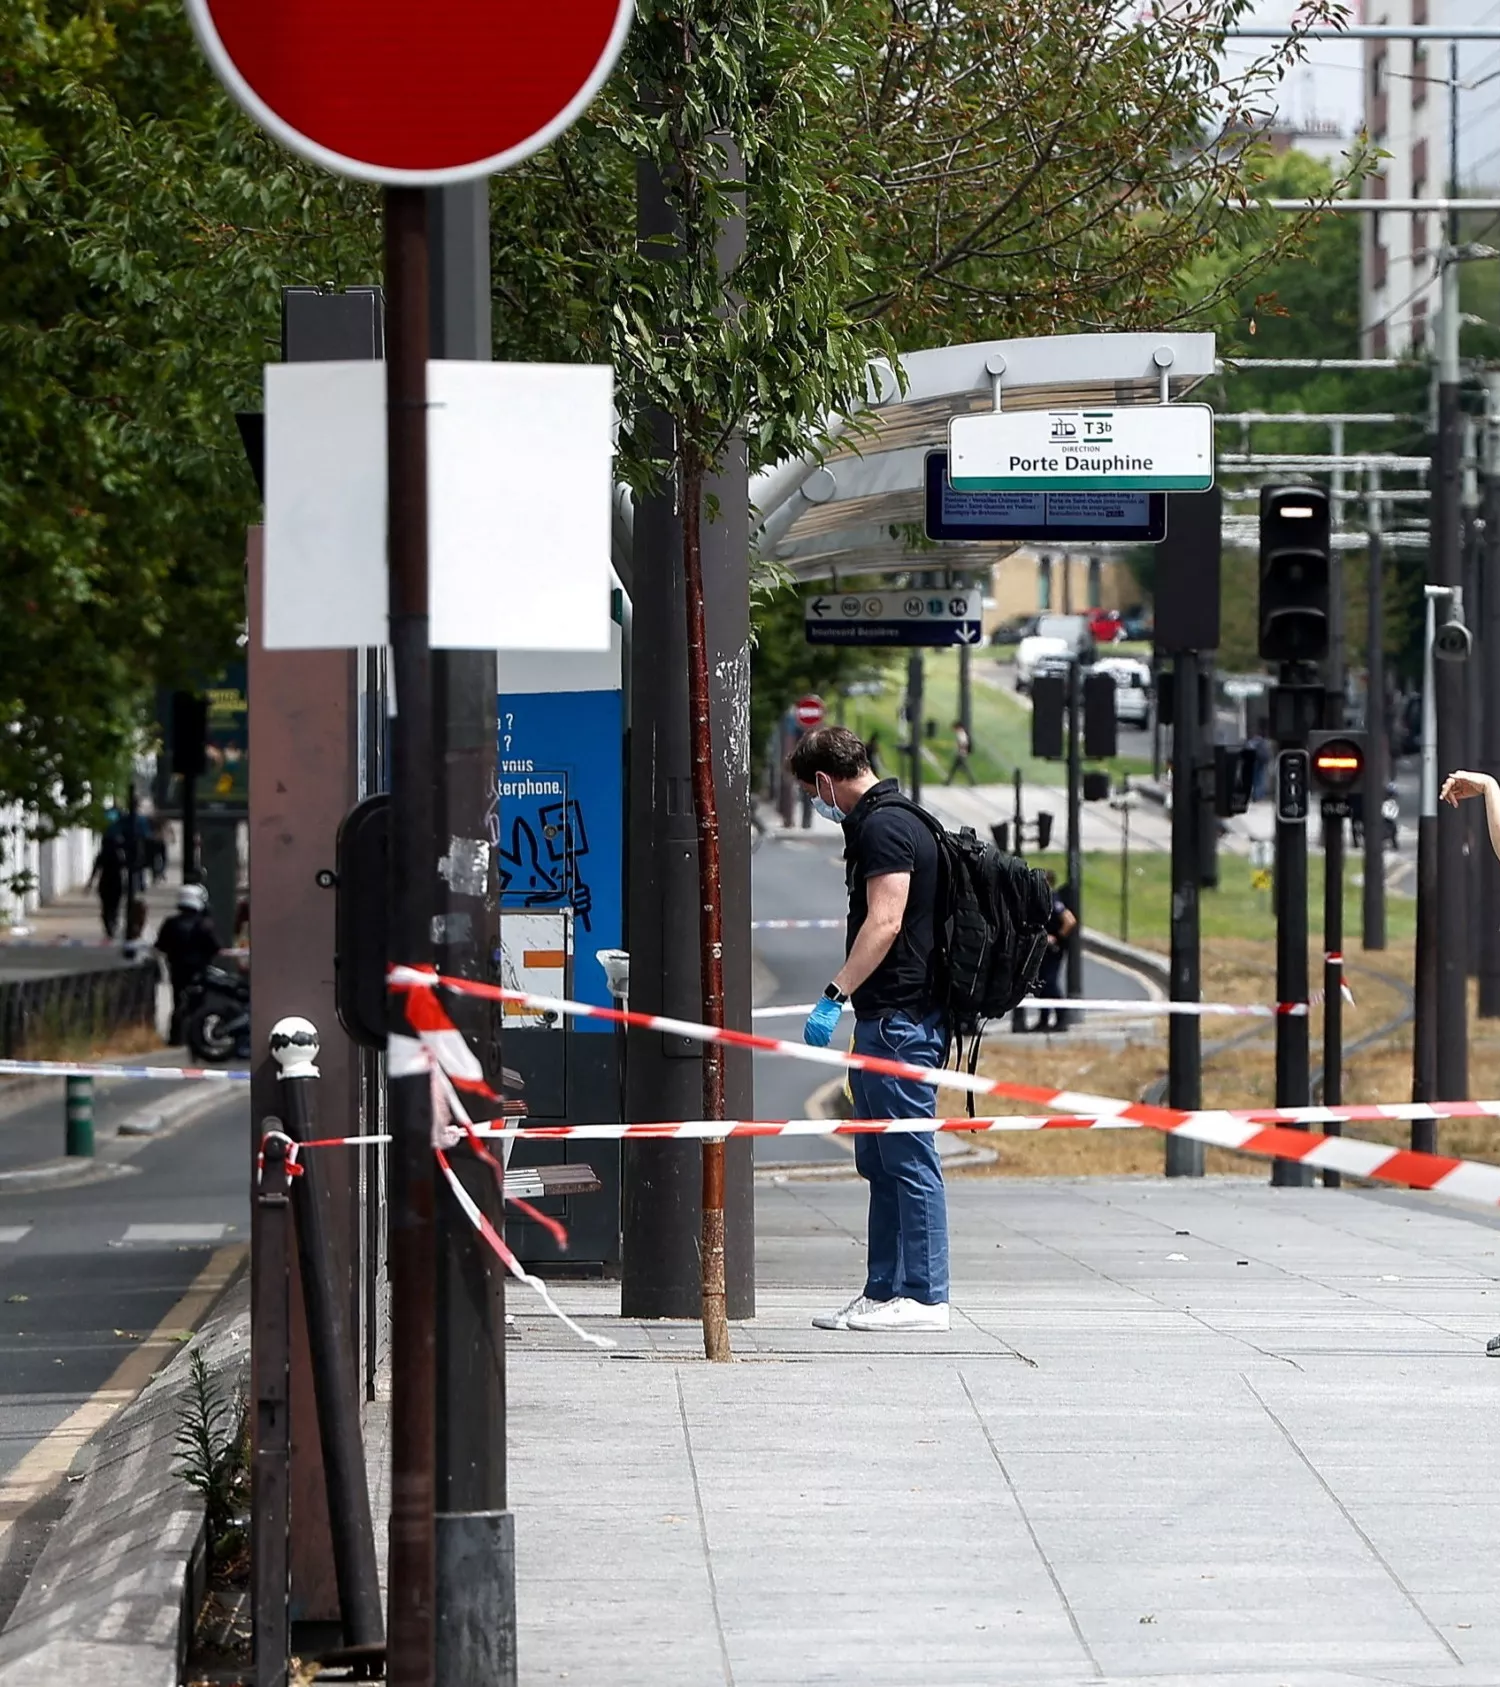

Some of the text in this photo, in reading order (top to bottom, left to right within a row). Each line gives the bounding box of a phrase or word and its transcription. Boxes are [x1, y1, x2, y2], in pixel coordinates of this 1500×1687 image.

[1009, 455, 1154, 474] Porte Dauphine
[868, 602, 877, 613] C
[950, 601, 966, 614] 14
[502, 759, 534, 772] vous
